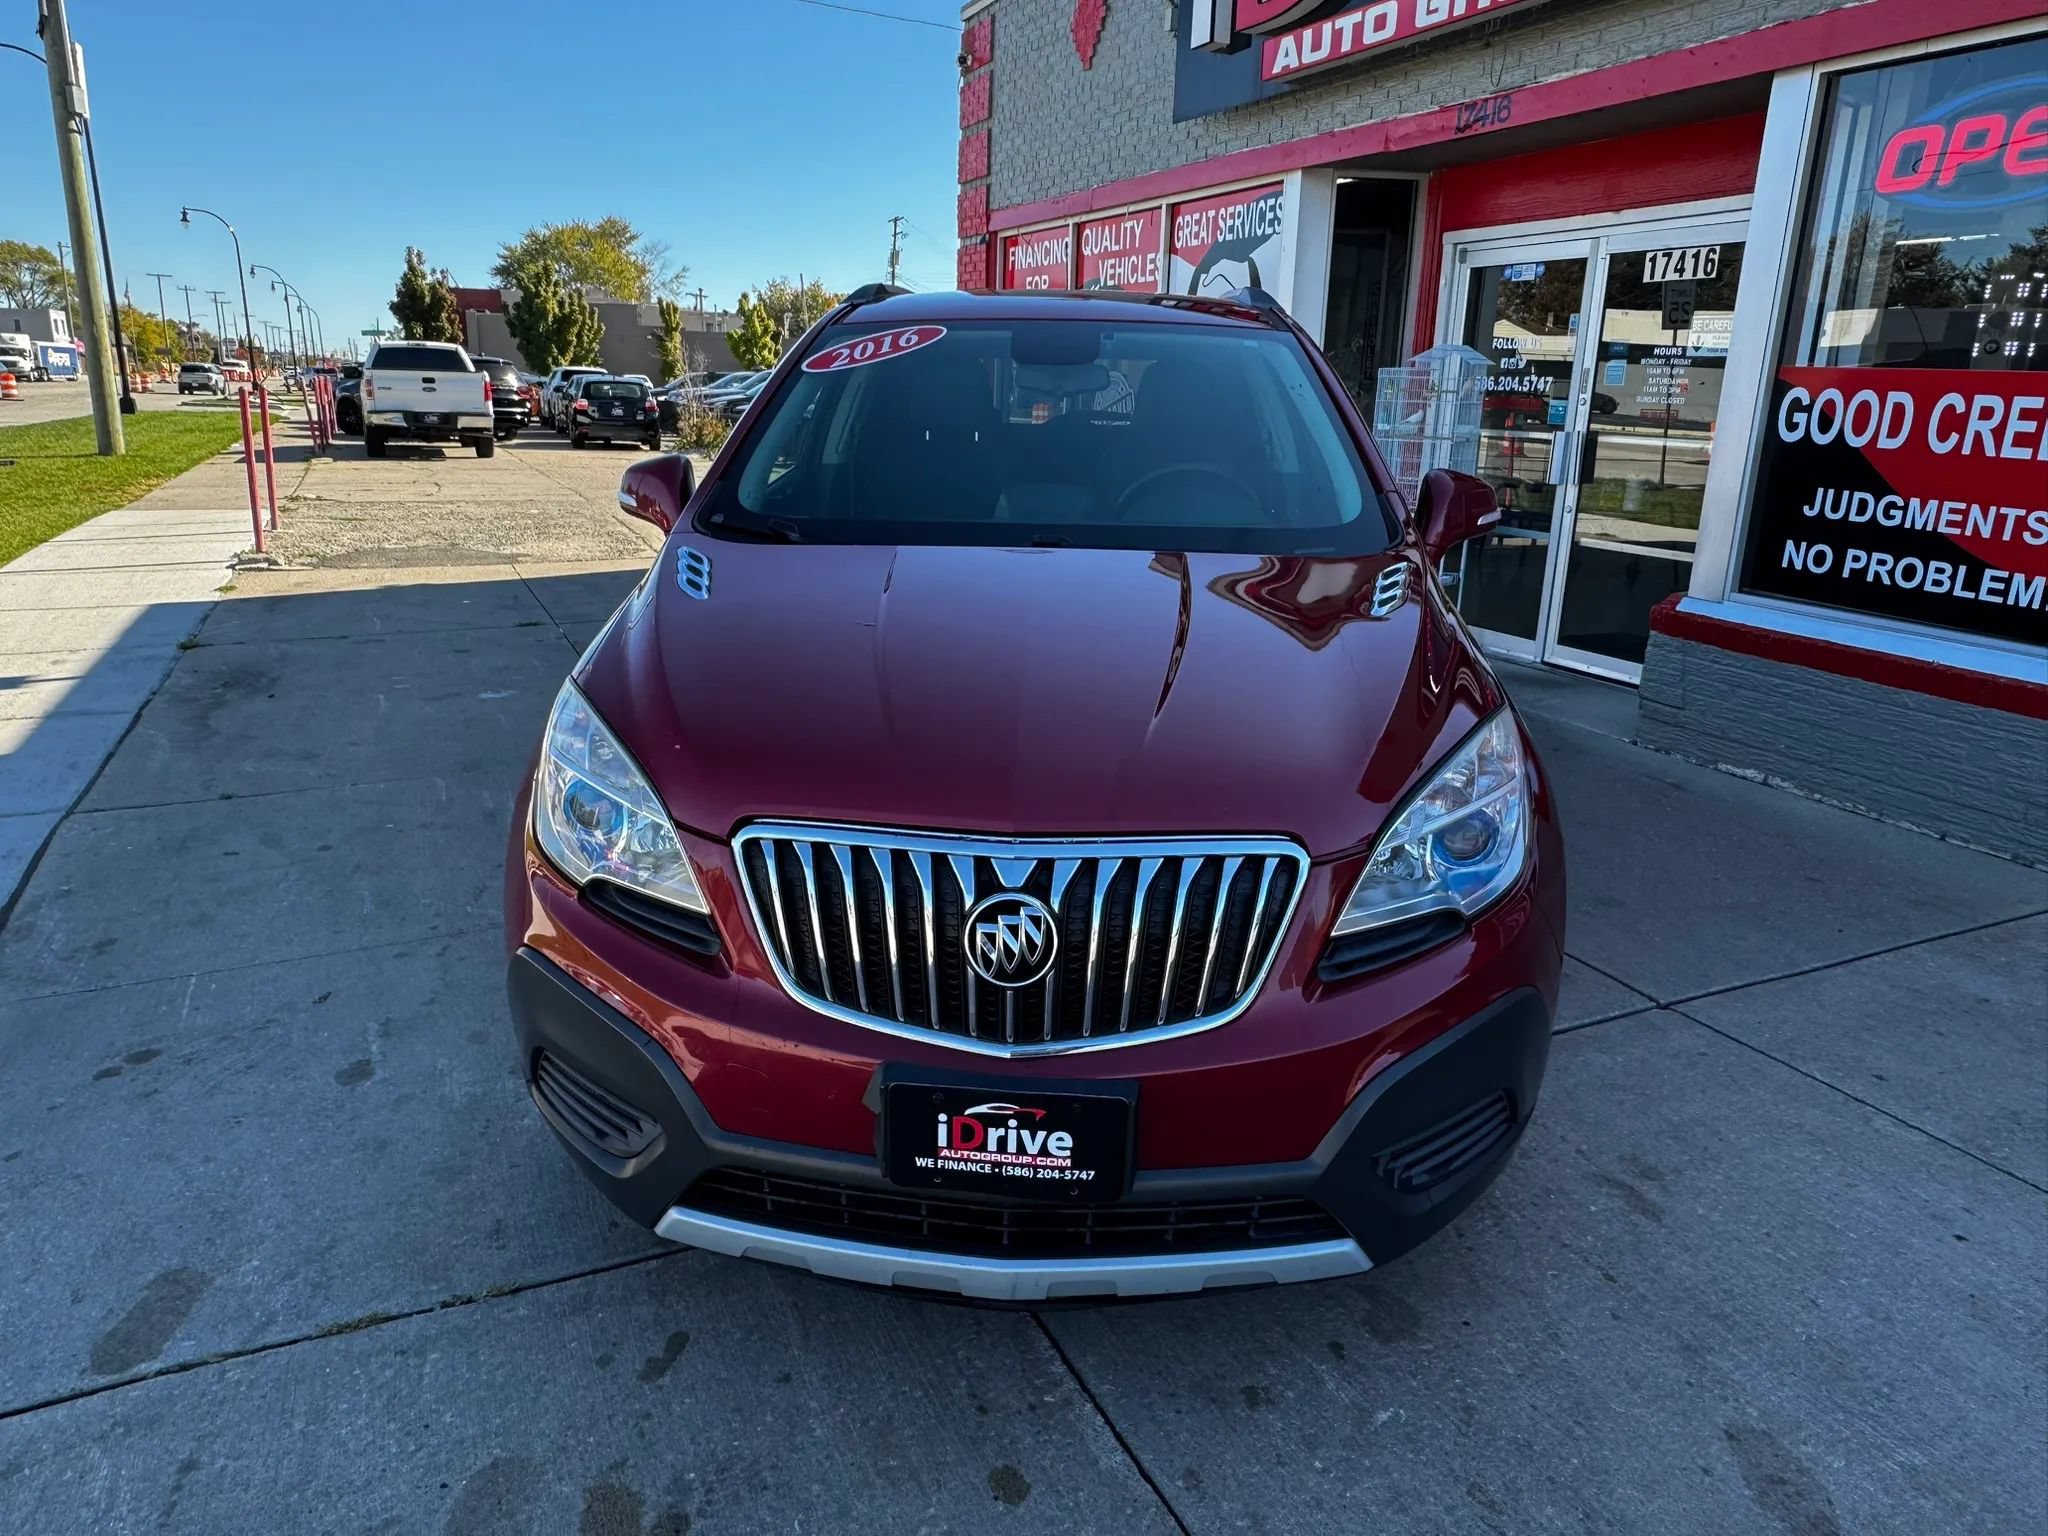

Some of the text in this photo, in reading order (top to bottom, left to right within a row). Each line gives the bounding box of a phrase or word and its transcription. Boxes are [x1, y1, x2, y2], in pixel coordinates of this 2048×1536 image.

[1271, 0, 1398, 75] AUTO
[1455, 95, 1513, 134] 17416
[1875, 105, 2048, 194] OPE
[1082, 218, 1144, 256] QUALITY
[1174, 195, 1284, 249] GREAT SERVICES
[1648, 247, 1717, 280] 17416
[830, 328, 919, 368] 2016
[1492, 336, 1529, 349] FOLLOW
[1653, 347, 1683, 356] HOURS
[1669, 358, 1692, 366] FRIDAY
[1475, 376, 1553, 392] 586.204.5747
[1660, 396, 1685, 404] CLOSED
[1777, 386, 2048, 461] GOOD CRE
[1803, 487, 2048, 546] JUDGMENTS
[1781, 539, 2048, 611] NO PROBLEM
[937, 1113, 1073, 1156] iDrive
[915, 1156, 1095, 1181] WE FINANCE (586) 204-5747
[939, 1149, 1072, 1167] AUTOGROUP.COM
